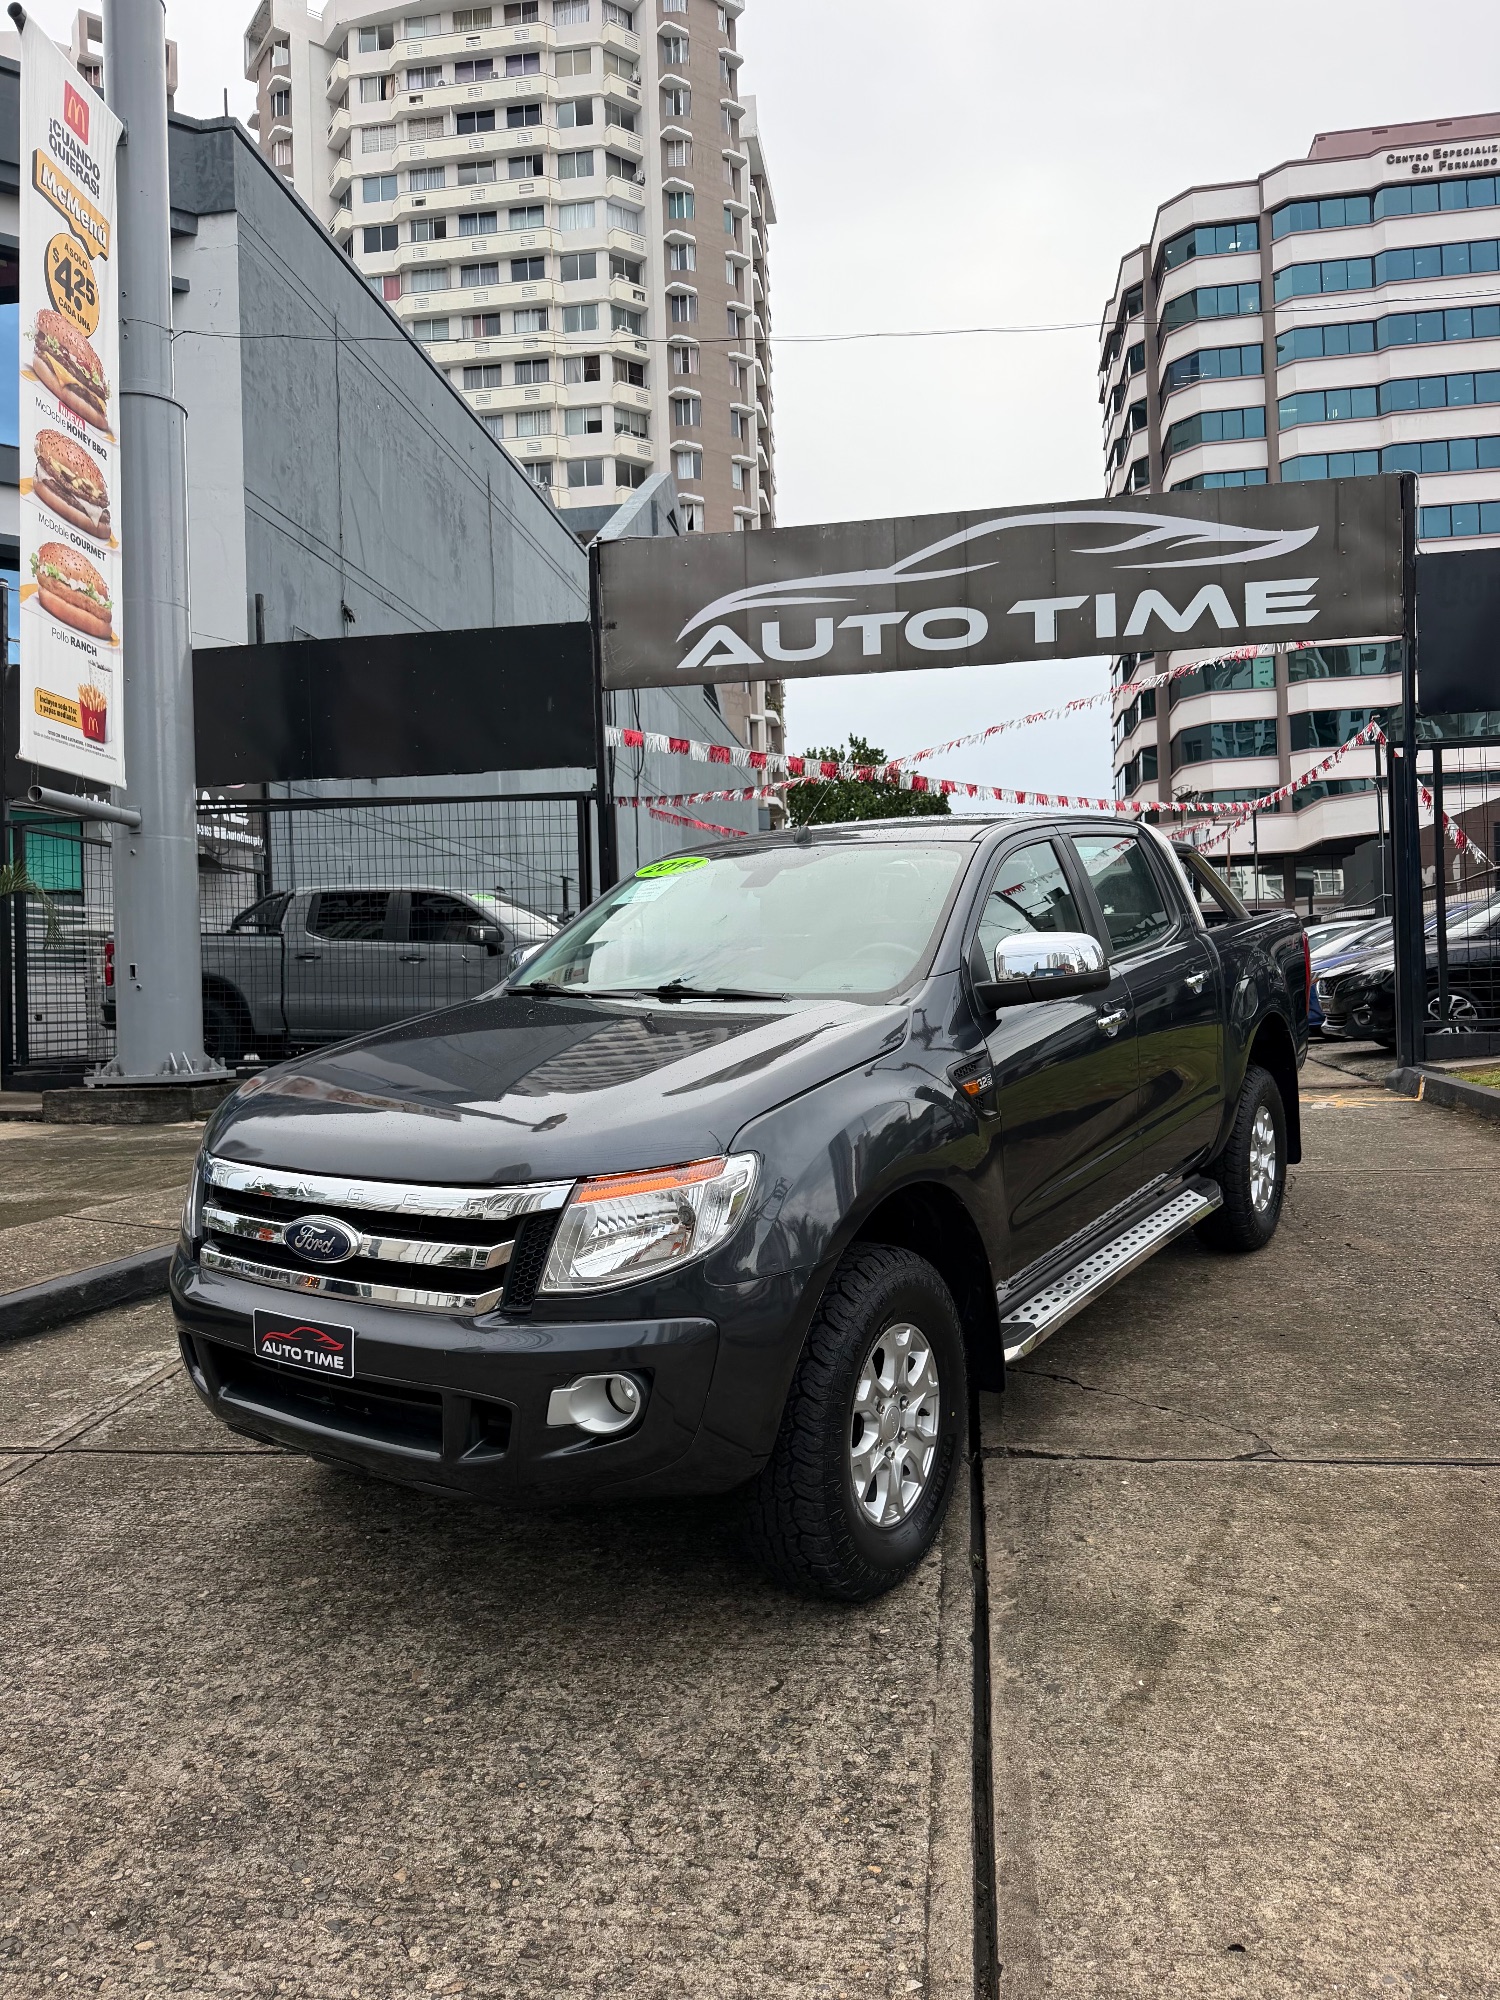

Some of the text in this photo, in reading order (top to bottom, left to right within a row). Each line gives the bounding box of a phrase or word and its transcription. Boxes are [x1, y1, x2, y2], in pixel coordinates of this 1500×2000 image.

[49, 117, 100, 180] ¡CUANDO
[49, 134, 100, 199] QUIERAS!
[1411, 157, 1498, 174] SAN FERNANDO
[1433, 145, 1500, 159] ESPECIALIZ
[41, 163, 107, 249] McMenú
[58, 296, 91, 332] CADA UNA
[61, 404, 85, 430] NUEVA
[66, 420, 91, 447] HONEY
[91, 440, 107, 461] BBQ
[38, 512, 106, 560] McDoble GOURMET
[676, 577, 1320, 669] AUTO TIME
[51, 627, 97, 657] Pollo RANCH
[295, 1224, 335, 1255] Ford
[262, 1341, 344, 1370] AUTO TIME
